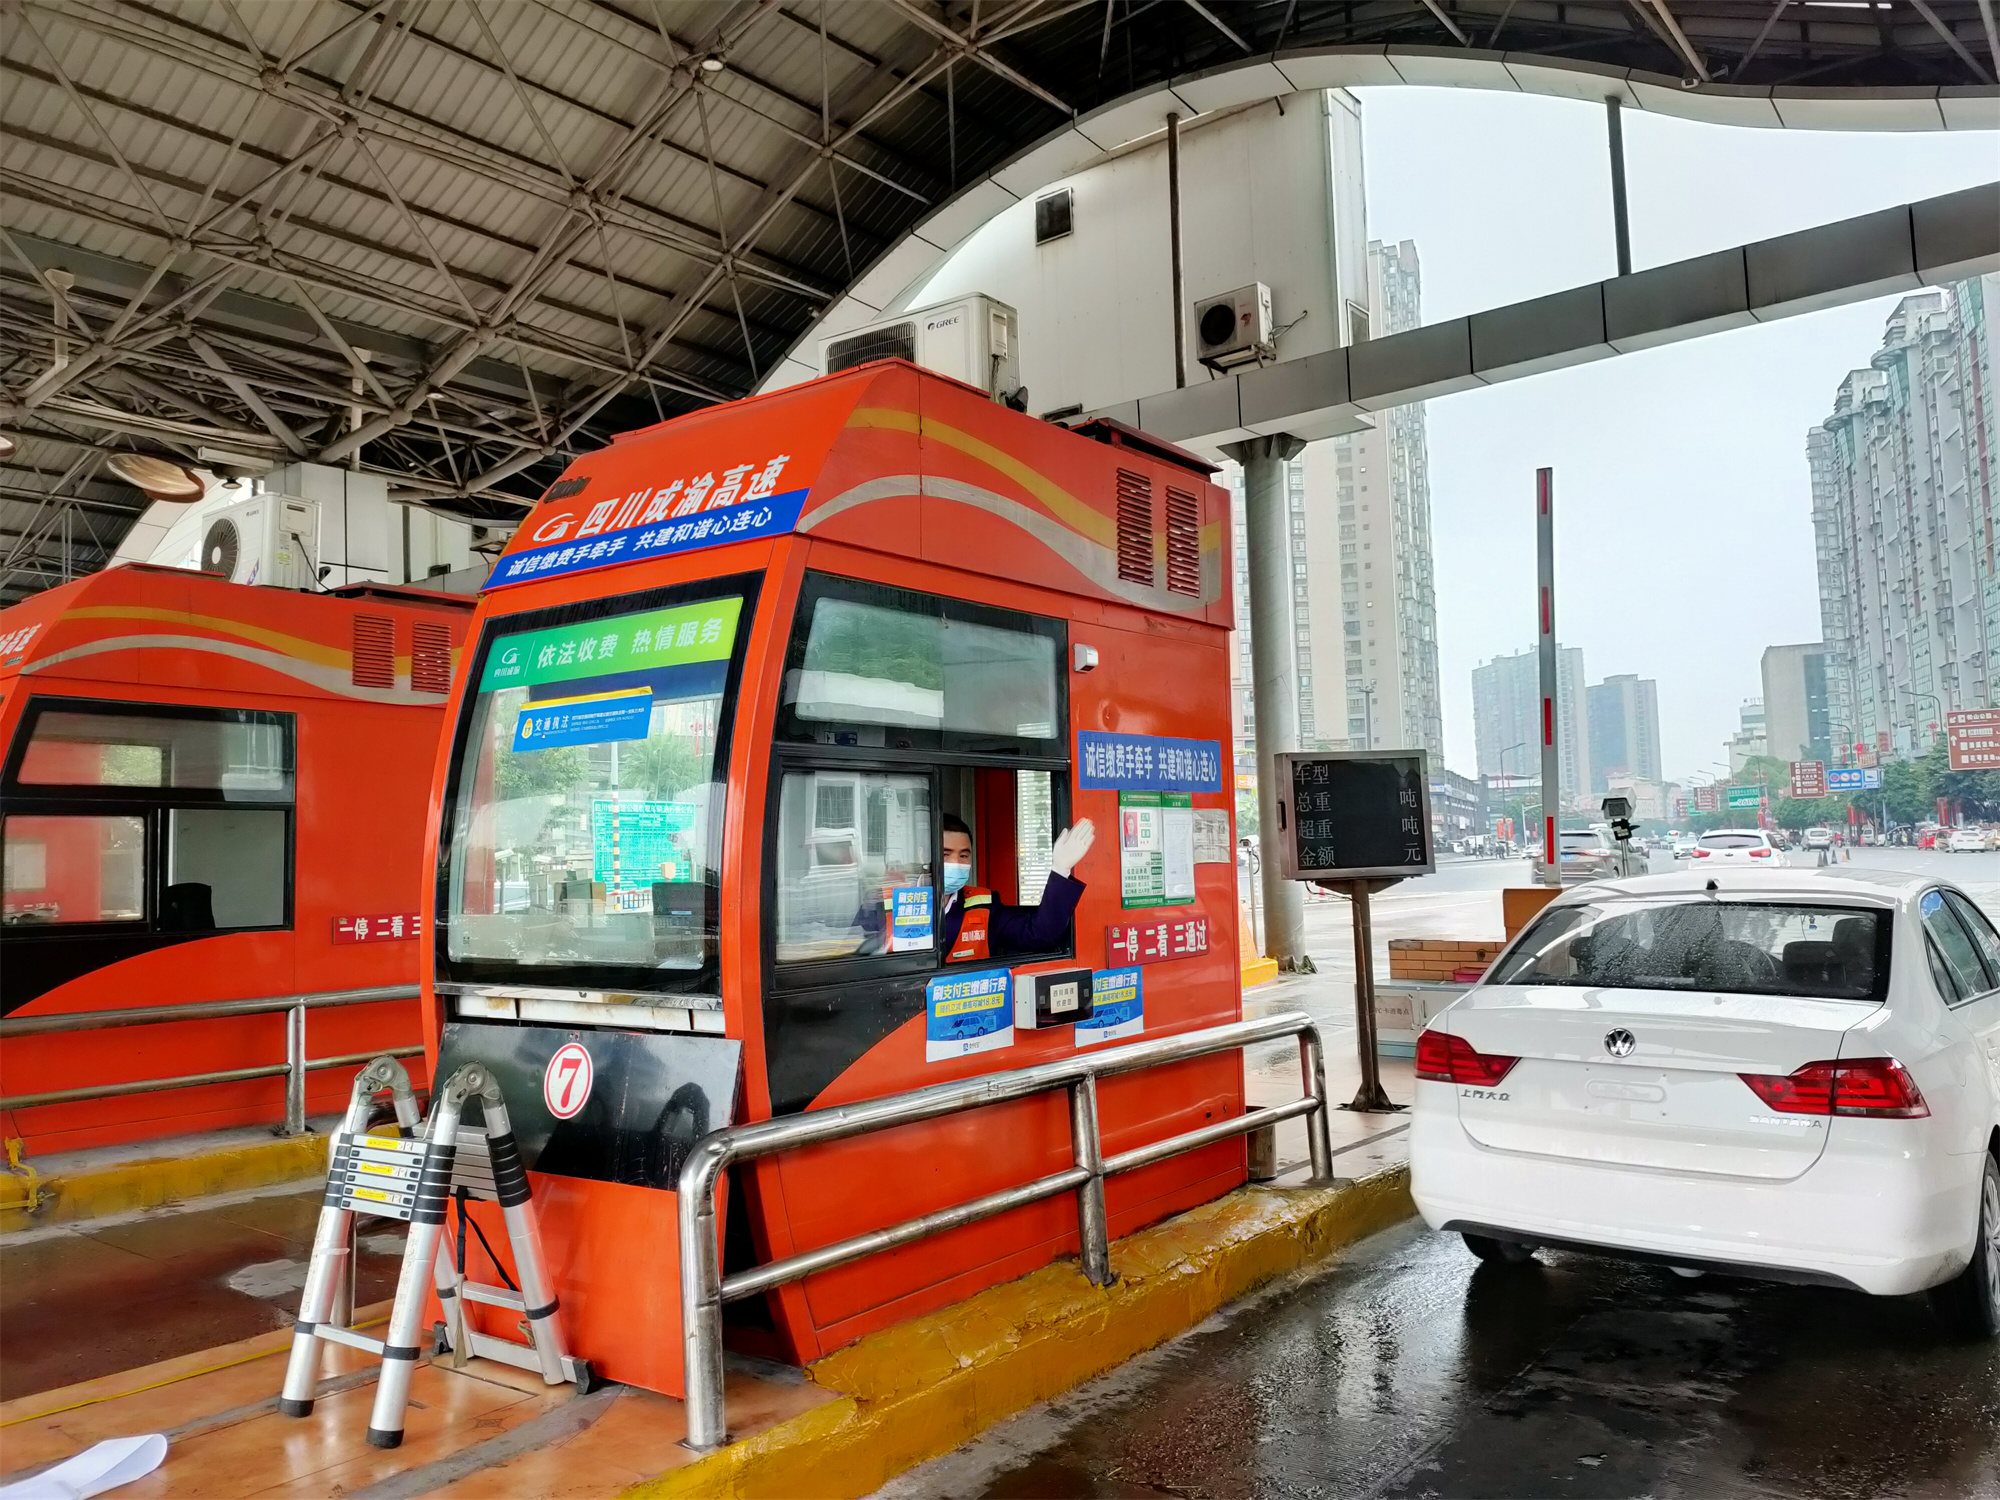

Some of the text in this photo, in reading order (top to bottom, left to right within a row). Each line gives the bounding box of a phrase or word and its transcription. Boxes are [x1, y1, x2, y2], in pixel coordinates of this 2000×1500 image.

[936, 316, 960, 329] GREE
[575, 454, 791, 539] 四川成渝高速
[505, 506, 773, 578] 诚信缴费手牵手 共建和谐心连心
[536, 617, 723, 669] 依法收费 热情服务
[534, 714, 570, 733] 交通执法
[1085, 741, 1153, 779] 诚信缴费手牵手
[1158, 746, 1217, 782] 共建和谐心连心
[1294, 764, 1330, 785] 车型
[1296, 788, 1417, 813] 总重 吨
[1297, 815, 1419, 840] 超重 吨
[1299, 842, 1421, 867] 金额 元
[898, 891, 928, 903] 刷支付宝
[897, 904, 927, 916] 缴通行费
[339, 917, 369, 940] 一停
[376, 915, 404, 938] 二看
[961, 929, 985, 942] 四川高速
[1113, 919, 1207, 962] 一停 二看 三通过
[932, 976, 1007, 1001] 刷支付宝缴通行费
[557, 1057, 582, 1109] 7
[1749, 1115, 1823, 1128] SANTANA
